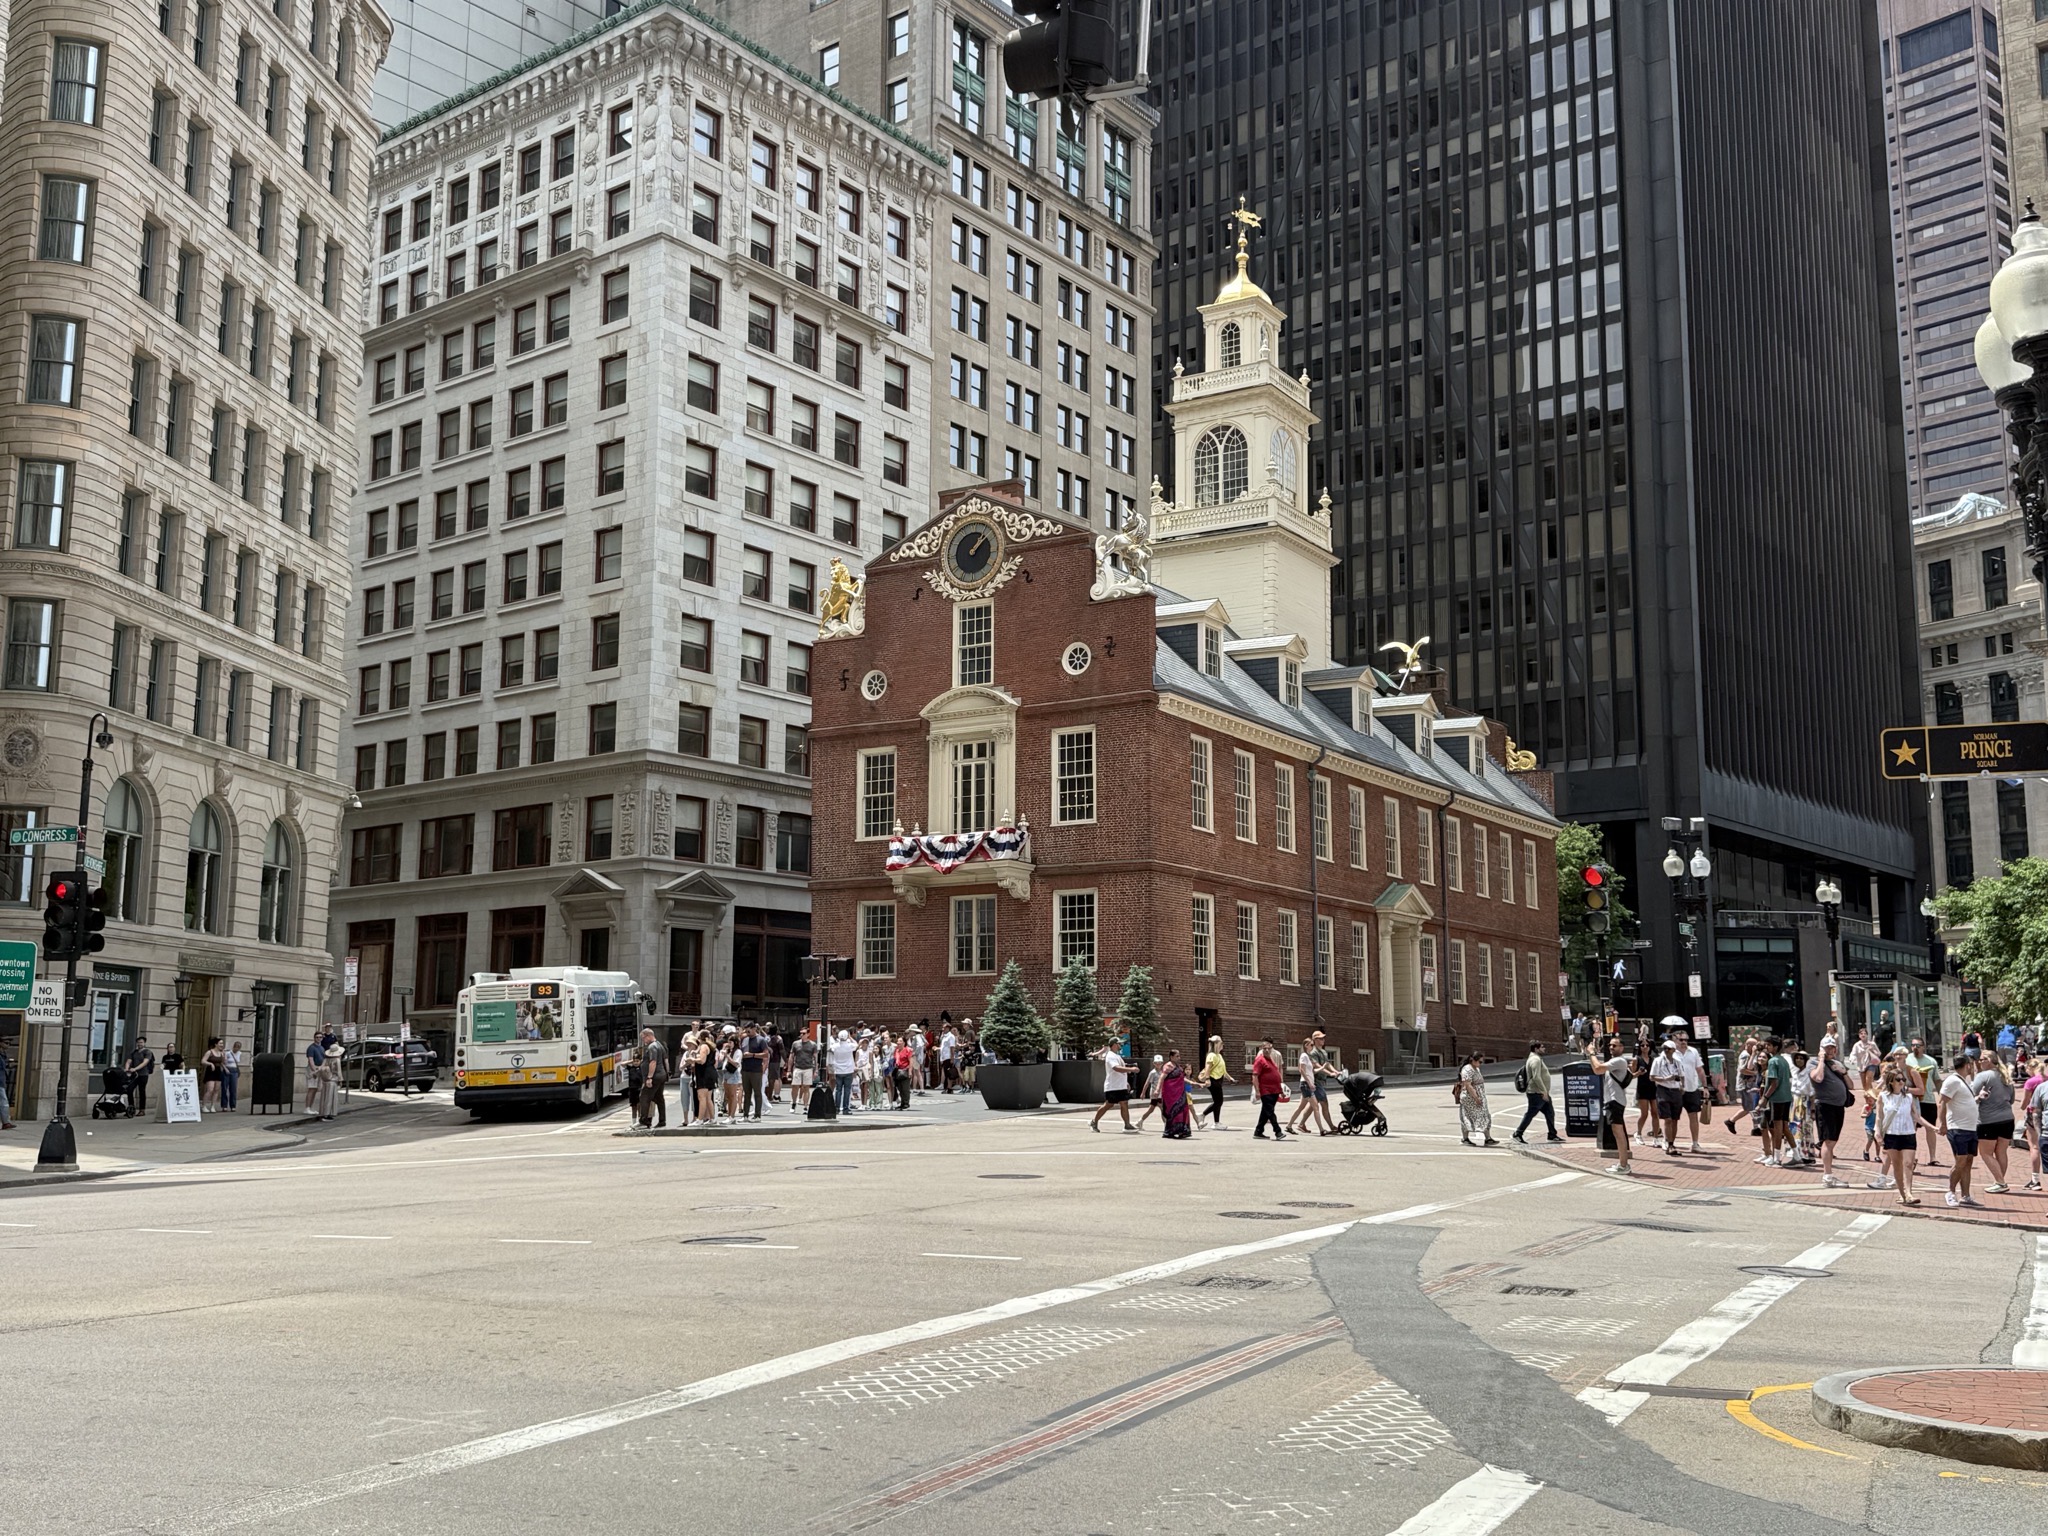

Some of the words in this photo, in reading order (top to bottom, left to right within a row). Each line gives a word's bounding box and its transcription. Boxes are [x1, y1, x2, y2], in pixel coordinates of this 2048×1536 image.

[1973, 733, 1998, 741] NORMAN
[1960, 740, 2013, 759] PRINCE
[1976, 760, 1998, 768] SQUARE
[22, 829, 67, 842] CONGRESS
[0, 959, 30, 967] owntown
[0, 968, 25, 980] rossing
[0, 982, 29, 991] overnment
[39, 987, 52, 995] NO
[538, 985, 552, 995] 93
[0, 993, 16, 1001] enter
[33, 997, 58, 1006] TURN
[28, 1006, 42, 1016] ON
[43, 1007, 61, 1017] RED
